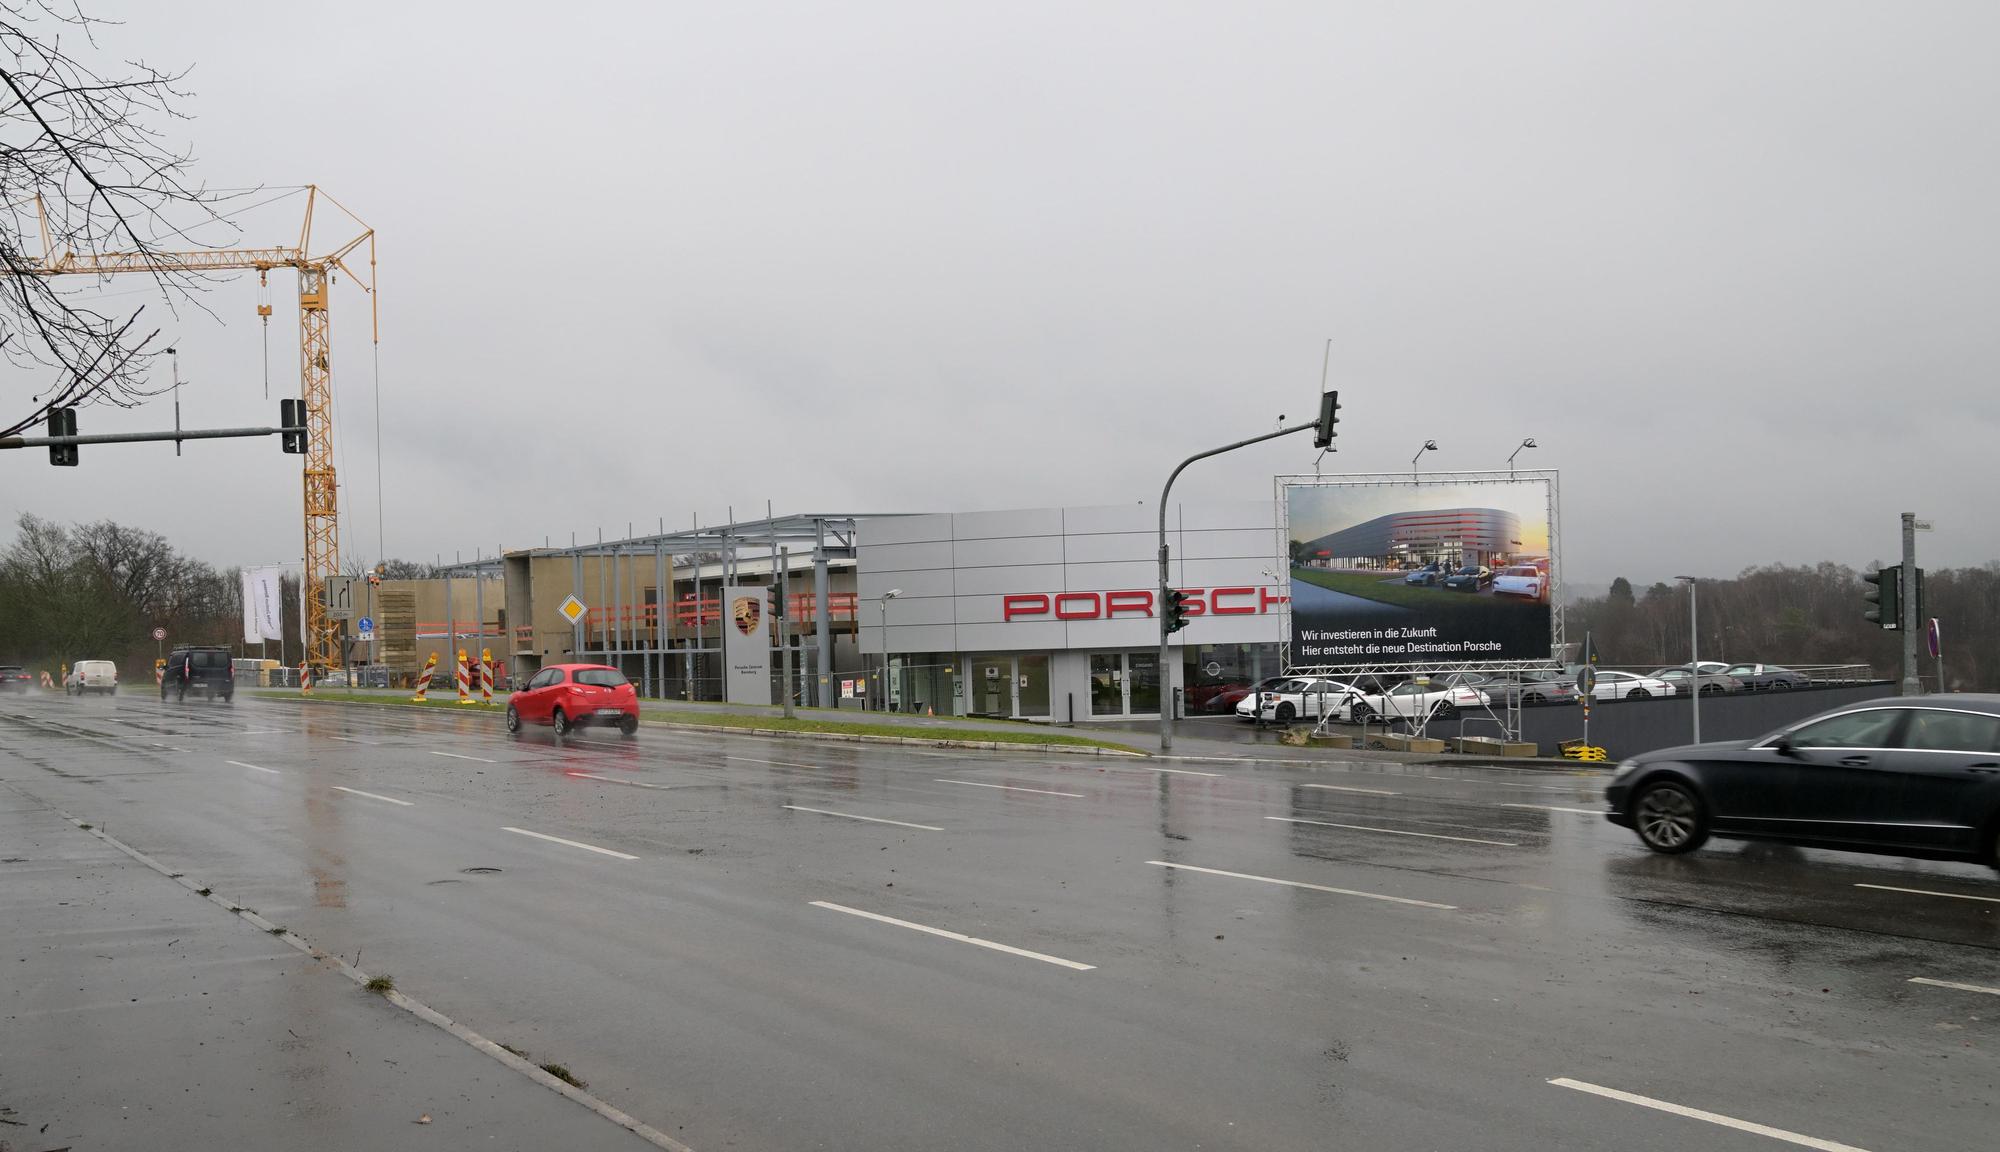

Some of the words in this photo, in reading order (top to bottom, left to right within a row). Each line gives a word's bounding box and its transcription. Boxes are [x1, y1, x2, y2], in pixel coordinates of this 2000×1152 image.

[1301, 630, 1318, 640] Wir
[1320, 629, 1371, 640] investieren
[1374, 628, 1383, 638] in
[1385, 628, 1399, 638] die
[1401, 627, 1437, 638] Zukunft
[1302, 645, 1321, 656] Hier
[1323, 644, 1364, 655] entsteht
[1366, 643, 1380, 654] die
[1382, 644, 1405, 653] neue
[1407, 641, 1461, 653] Destination
[1464, 640, 1502, 651] Porsche
